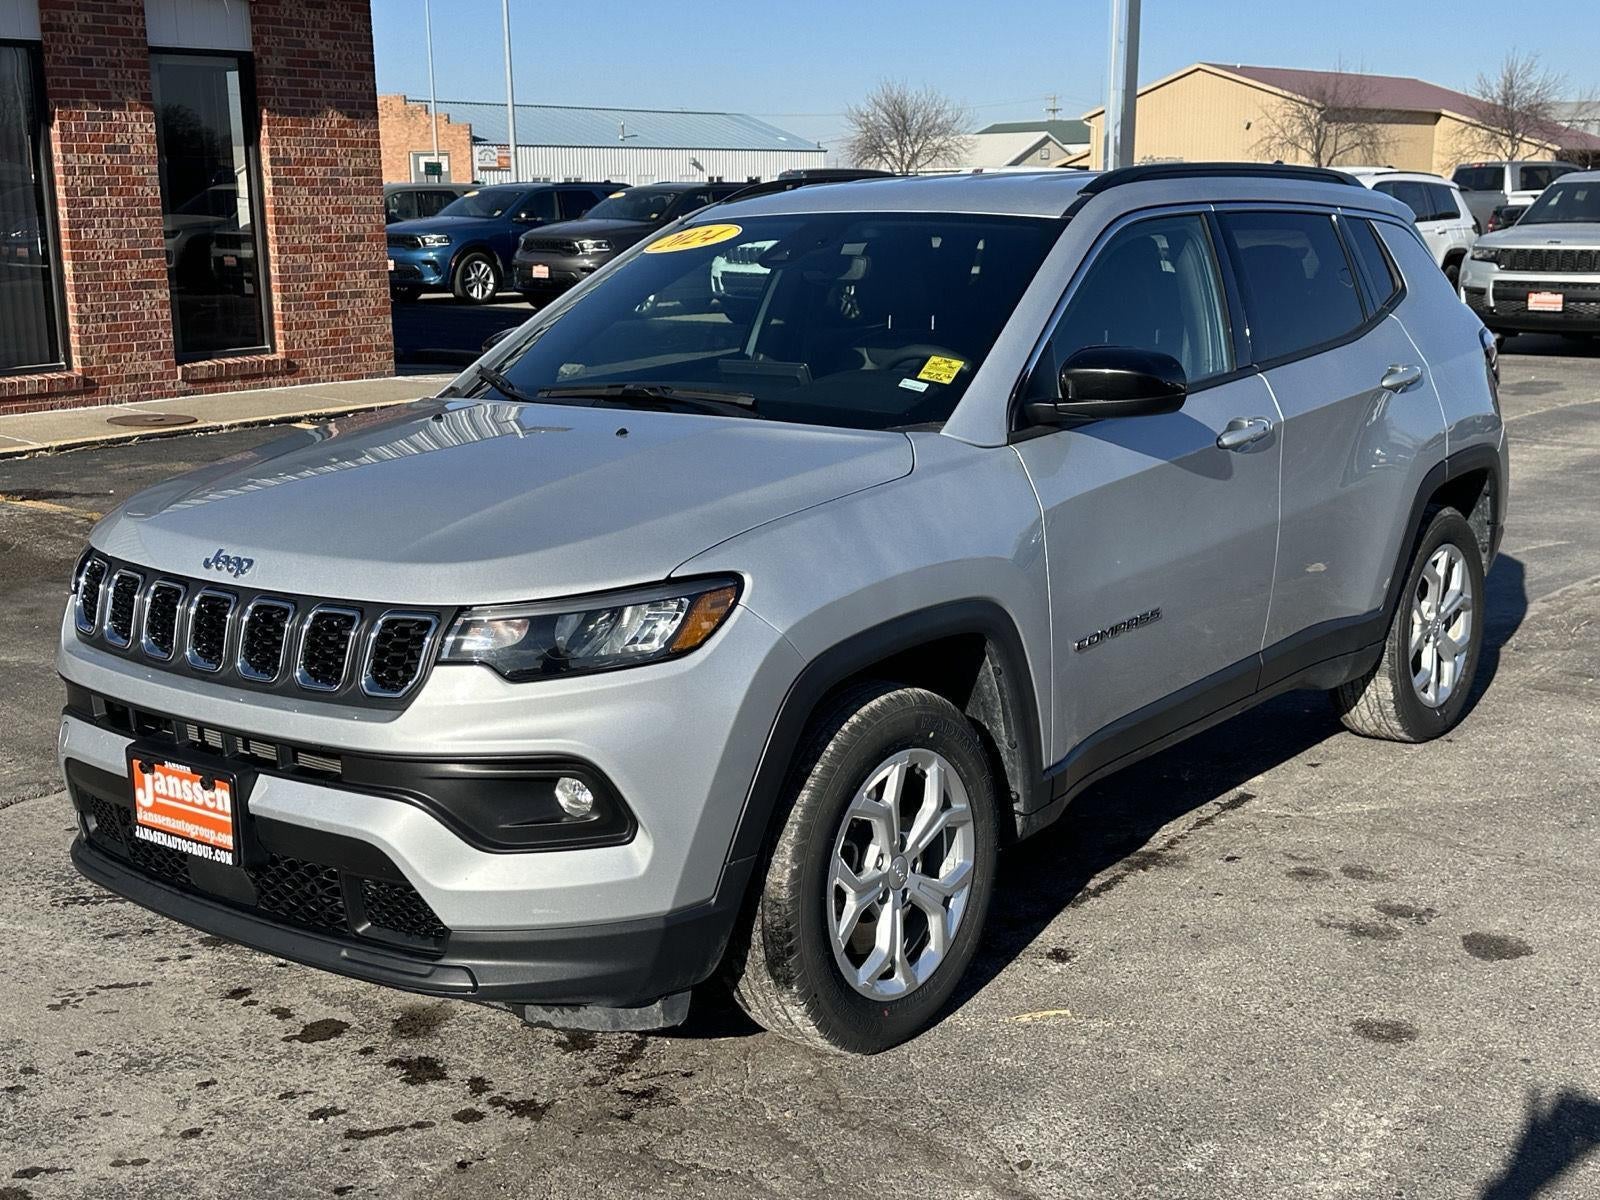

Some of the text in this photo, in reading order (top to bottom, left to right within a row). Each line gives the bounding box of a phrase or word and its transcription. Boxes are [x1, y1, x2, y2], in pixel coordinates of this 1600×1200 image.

[203, 548, 254, 579] Jeep
[1074, 607, 1162, 650] COMPASS
[137, 771, 231, 813] Janssen
[135, 825, 233, 866] JANSSENAUTOGROUP.COM
